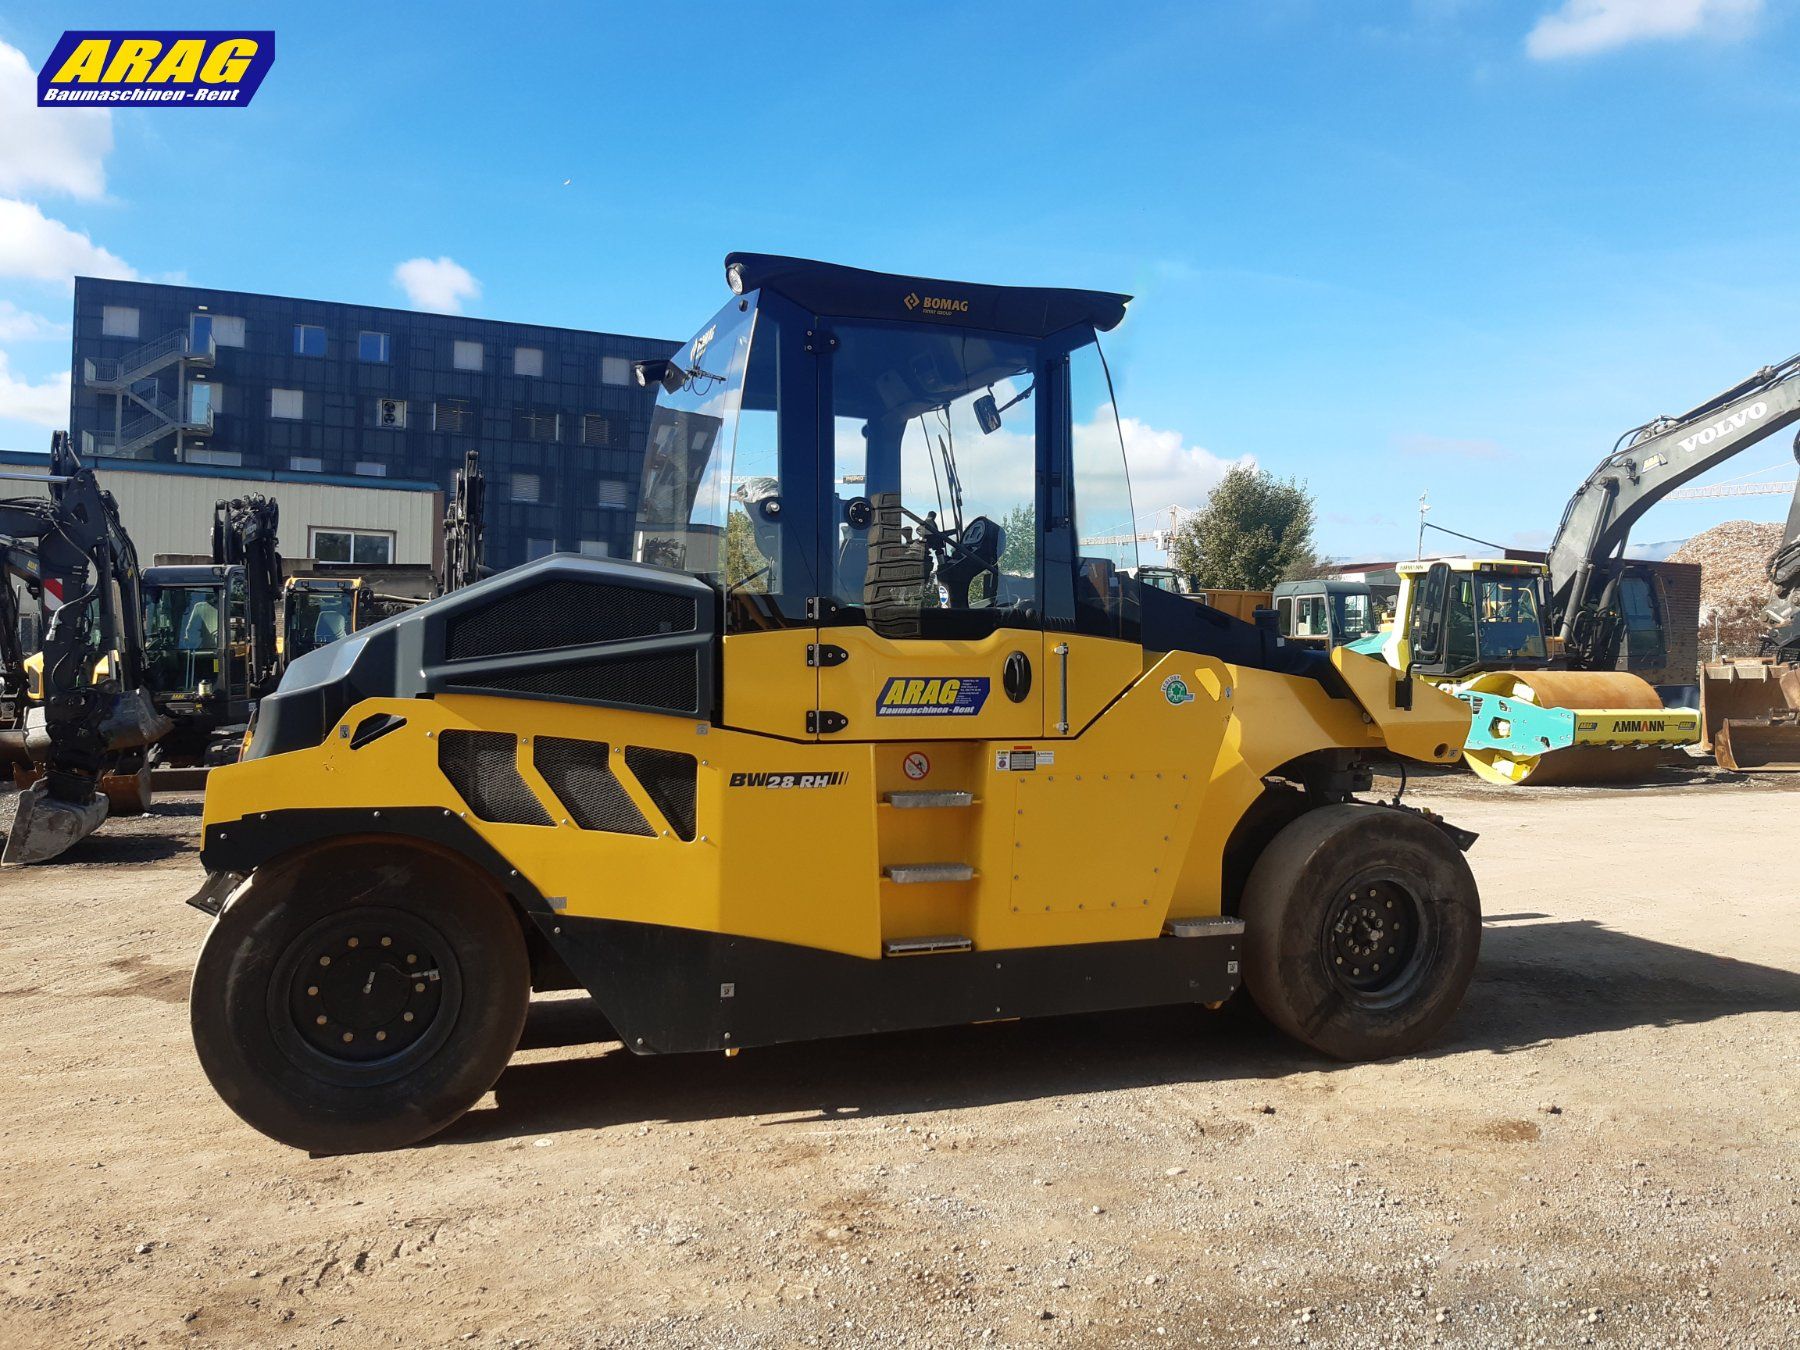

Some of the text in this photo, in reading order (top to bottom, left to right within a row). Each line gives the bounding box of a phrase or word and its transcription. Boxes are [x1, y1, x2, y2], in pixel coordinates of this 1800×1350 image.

[923, 297, 969, 311] BOMAG
[1678, 401, 1768, 453] VOLVO
[883, 679, 961, 705] ARAG
[1612, 721, 1665, 732] AMMANN
[799, 775, 830, 788] RH
